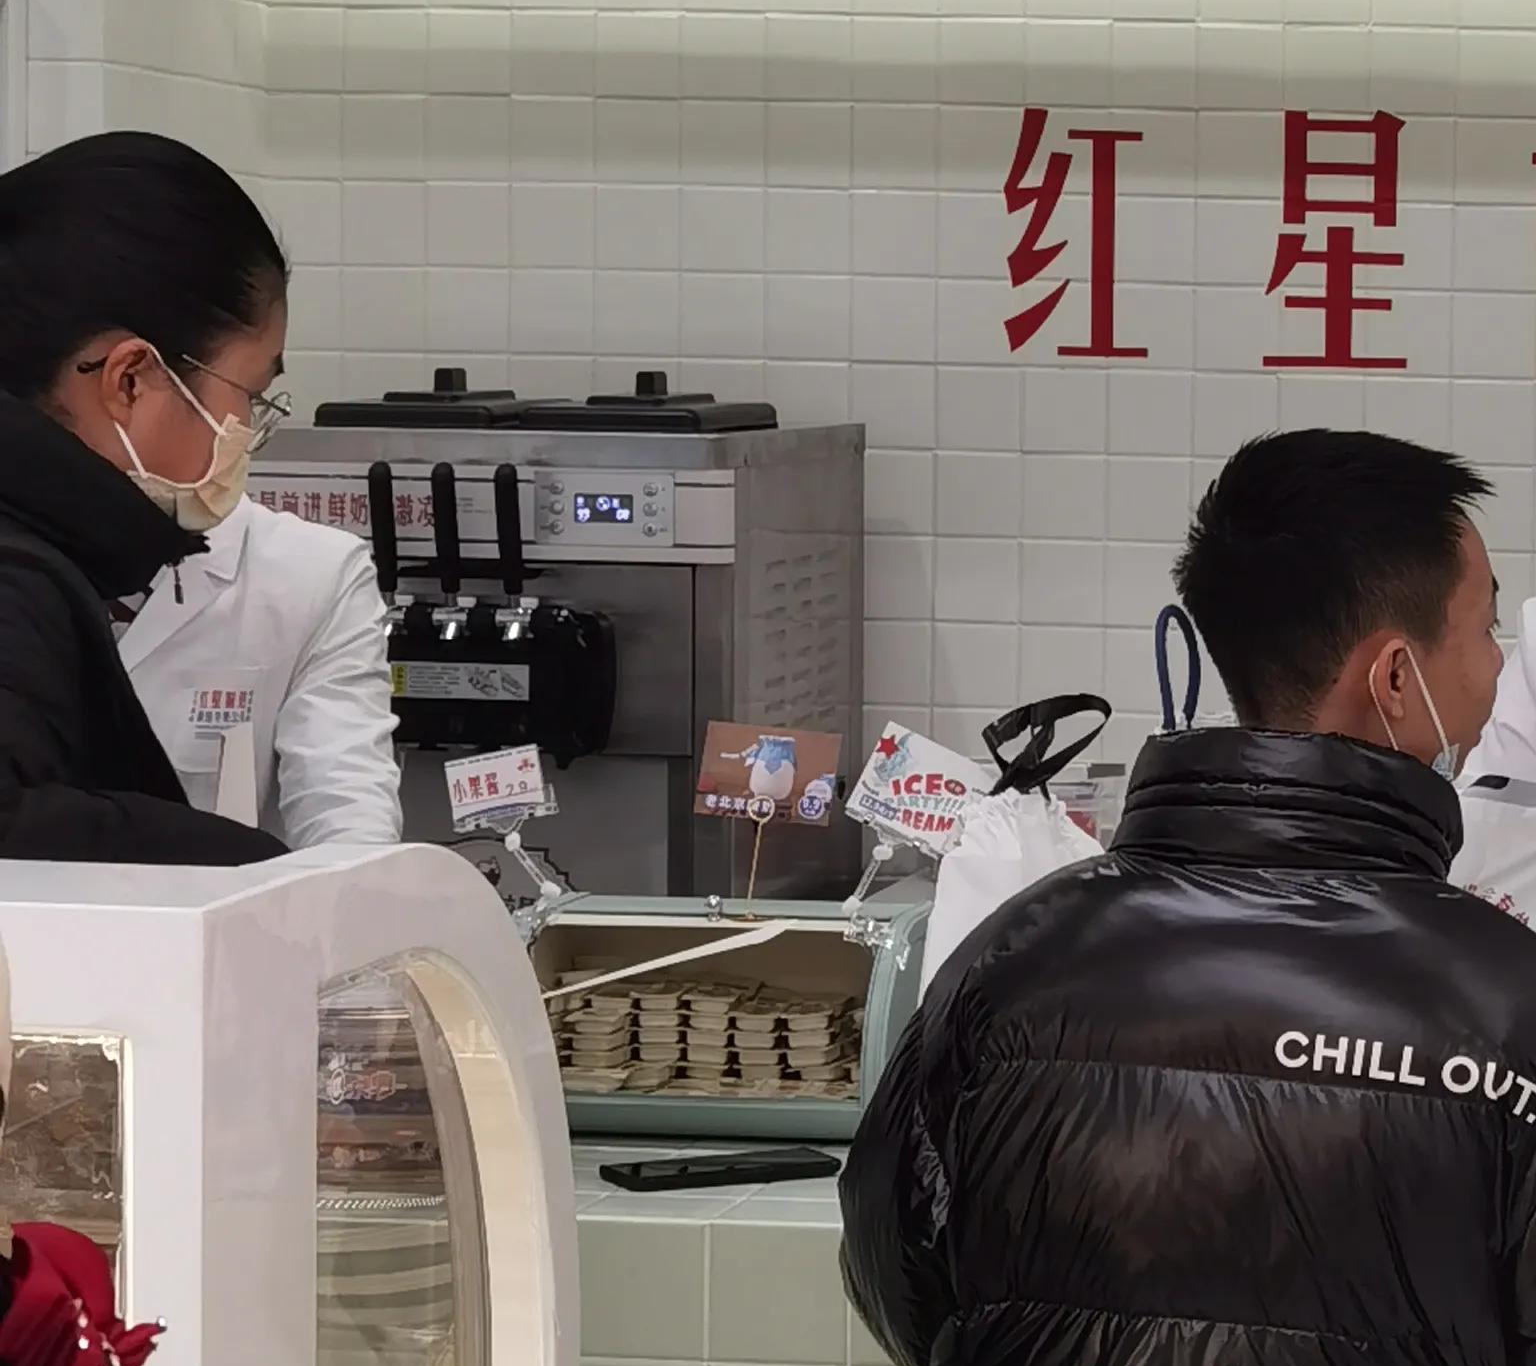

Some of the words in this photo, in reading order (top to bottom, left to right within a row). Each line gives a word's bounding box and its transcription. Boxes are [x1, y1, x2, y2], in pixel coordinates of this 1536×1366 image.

[892, 773, 945, 796] ICE
[896, 808, 956, 832] REAM
[1274, 1031, 1426, 1086] CHILL
